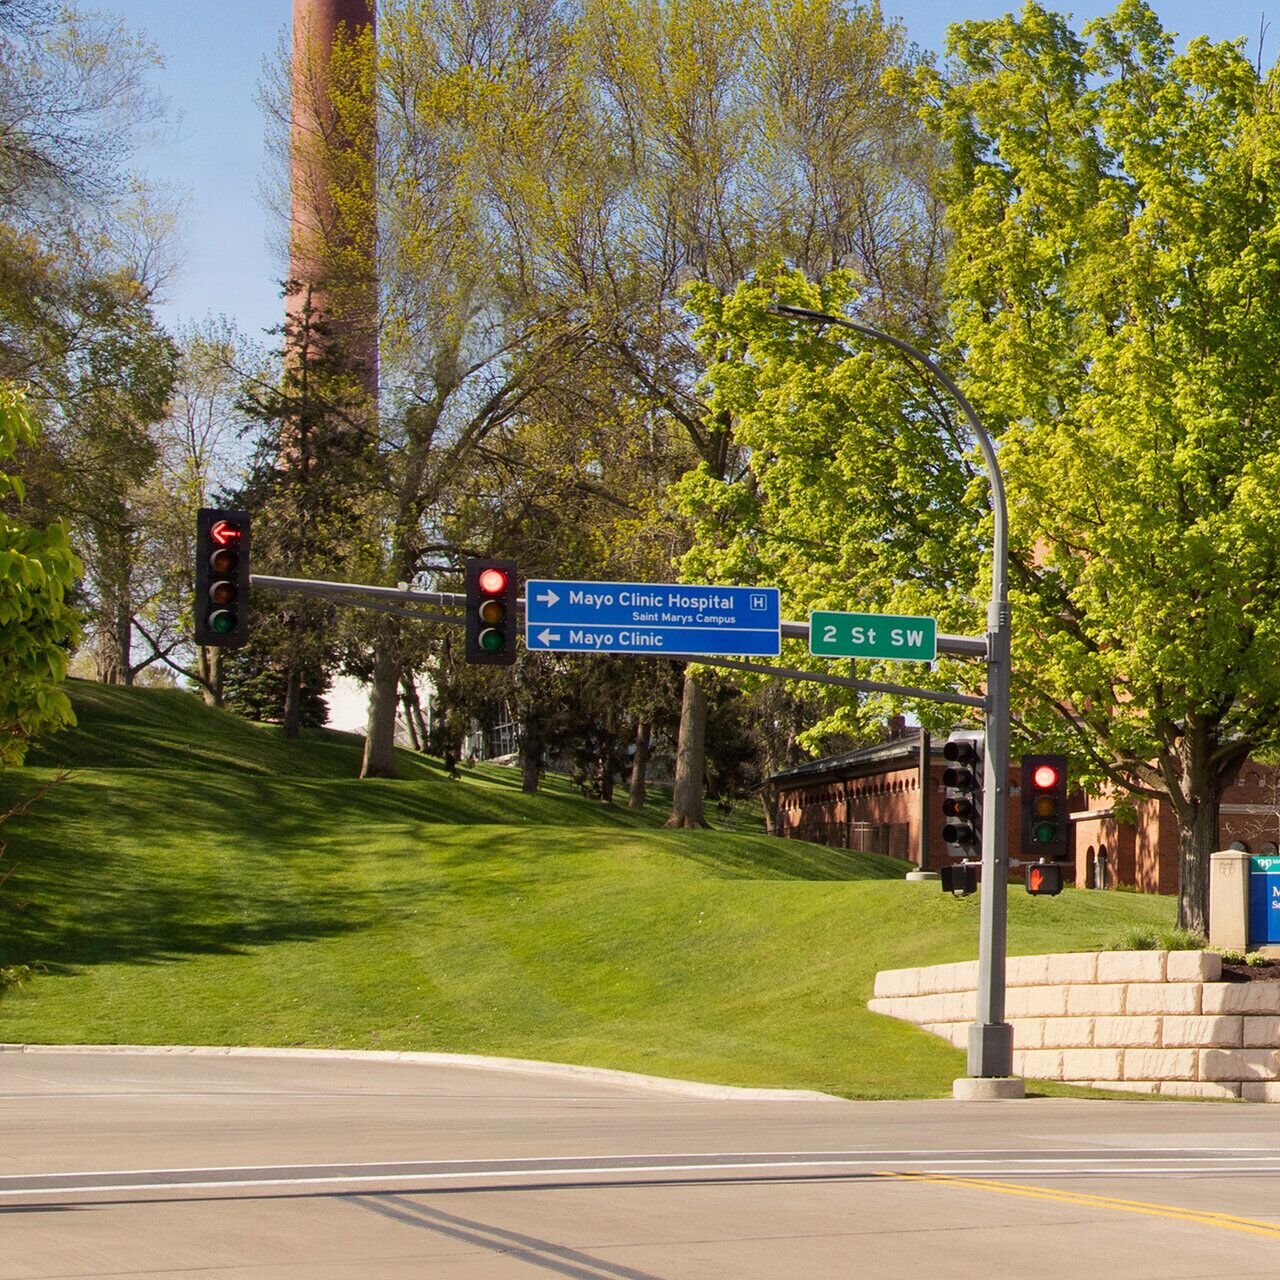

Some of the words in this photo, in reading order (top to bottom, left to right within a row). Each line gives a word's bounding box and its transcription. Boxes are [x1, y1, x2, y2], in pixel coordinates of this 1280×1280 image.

[569, 591, 613, 609] Mayo
[618, 592, 663, 607] Clinic
[668, 594, 734, 612] Hospital
[632, 612, 659, 622] Saint
[661, 613, 693, 624] Marys
[696, 614, 736, 626] Campus
[569, 631, 613, 649] Mayo
[618, 632, 663, 646] Clinic
[823, 625, 837, 642] 2
[851, 627, 876, 645] St
[891, 629, 924, 647] SW
